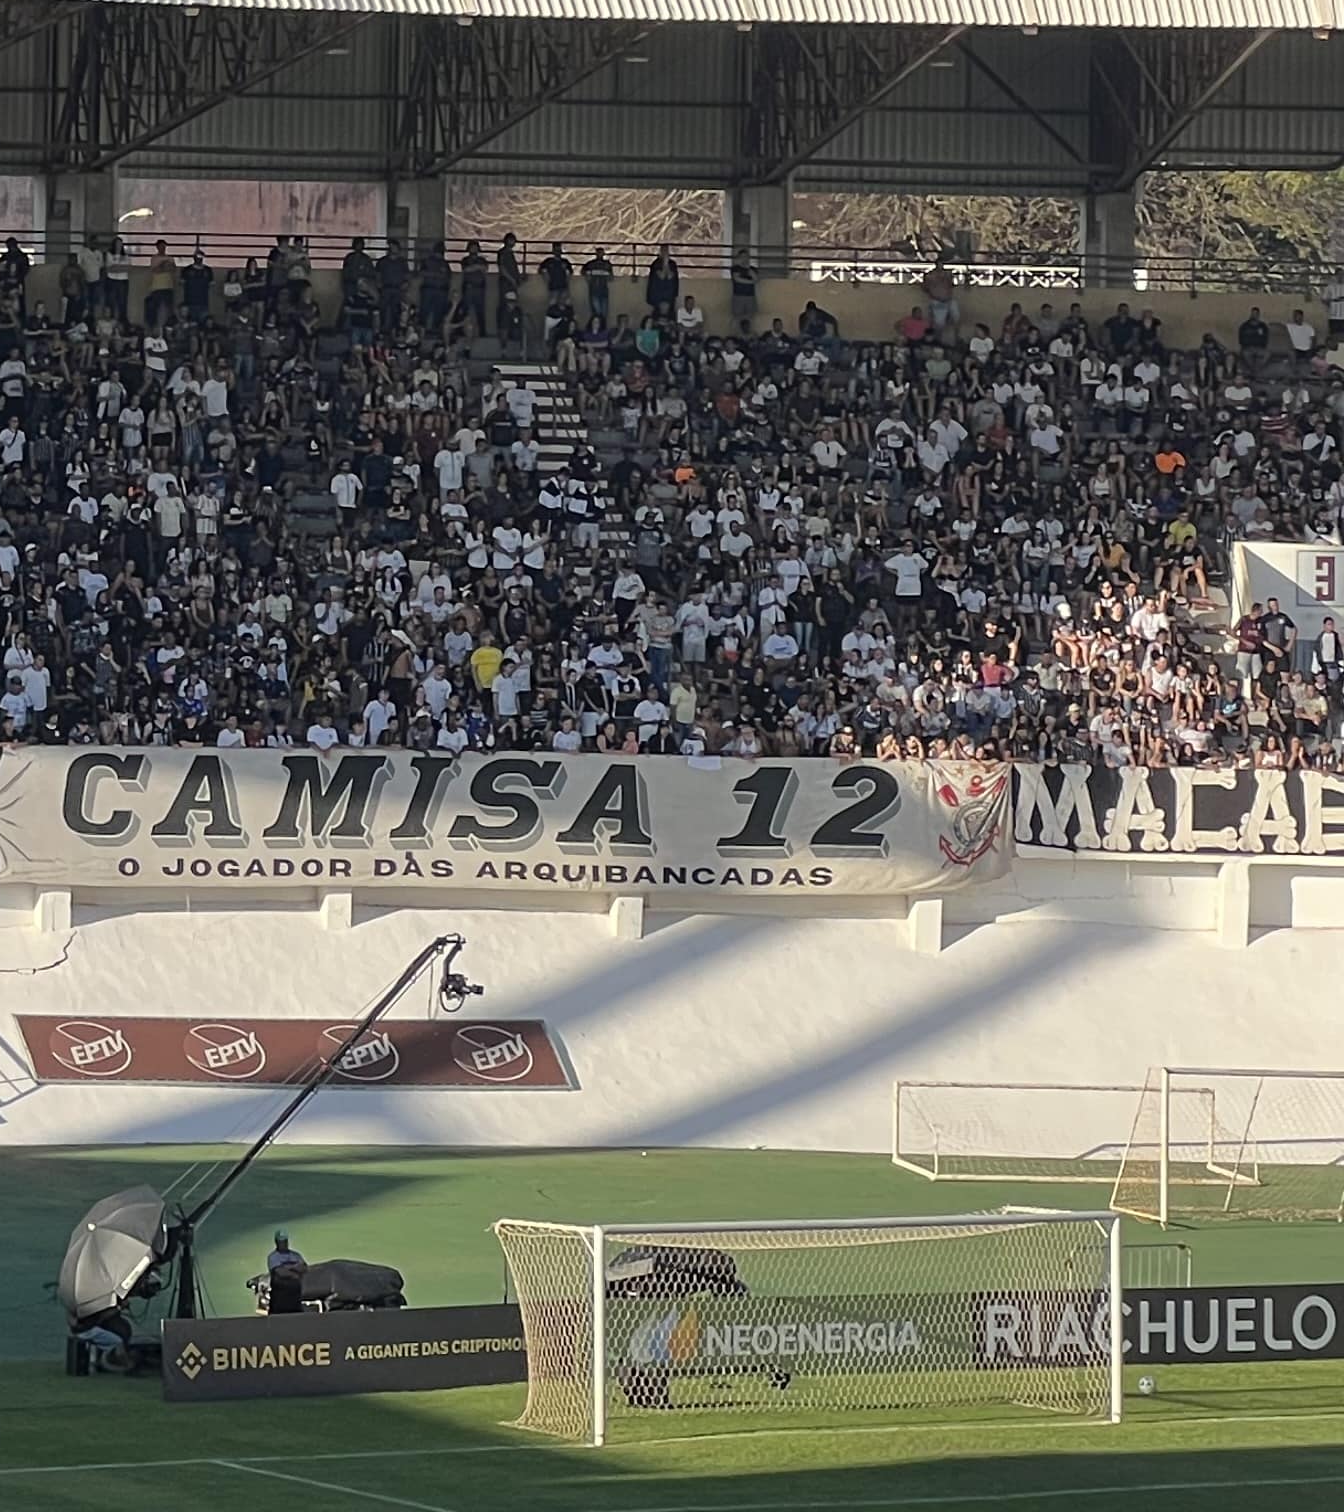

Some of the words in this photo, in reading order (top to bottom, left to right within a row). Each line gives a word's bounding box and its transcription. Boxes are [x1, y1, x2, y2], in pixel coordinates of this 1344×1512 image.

[1316, 556, 1335, 601] 3
[62, 752, 658, 857] CAMISA
[716, 764, 903, 859] 12
[120, 859, 140, 878] O
[163, 856, 353, 879] JOGADOR
[475, 861, 834, 887] ARQUIBANCADAS
[69, 1029, 124, 1067] EPTV
[204, 1031, 259, 1070] EPTV
[472, 1031, 524, 1071] EPTV
[705, 1321, 921, 1356] NEOENERGIA
[985, 1294, 1337, 1358] RIACHUELO
[213, 1342, 331, 1371] BINANCE
[345, 1346, 355, 1360] A
[357, 1342, 419, 1360] GIGANTE
[421, 1340, 449, 1356] DAS
[451, 1337, 526, 1354] CRIPTOMO
